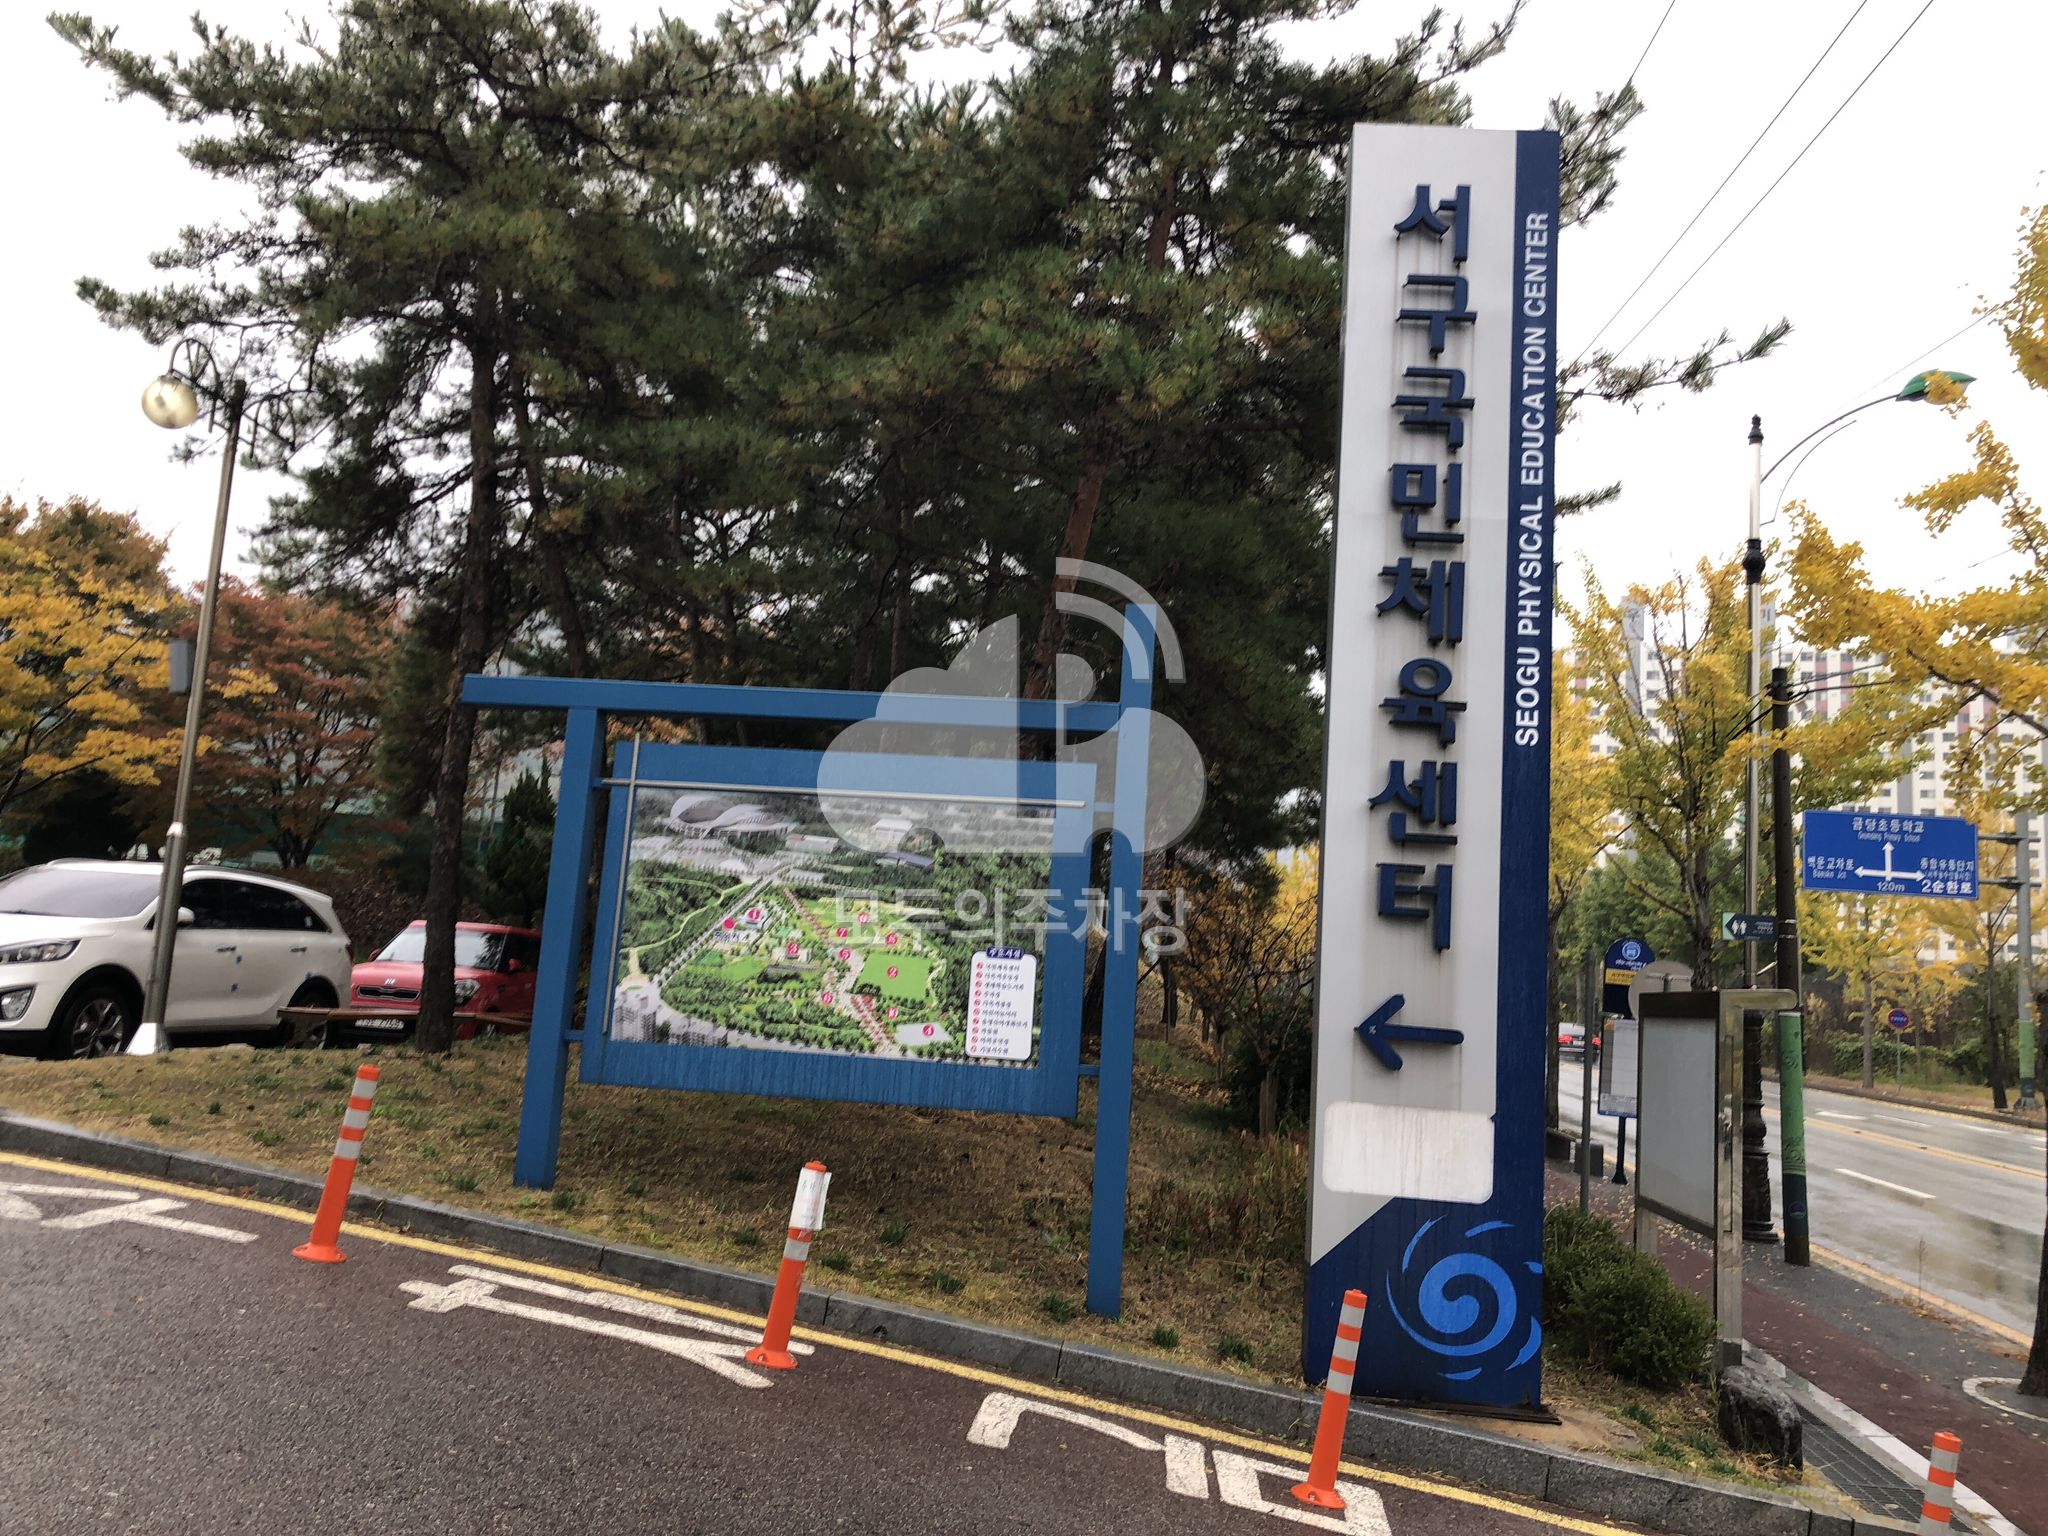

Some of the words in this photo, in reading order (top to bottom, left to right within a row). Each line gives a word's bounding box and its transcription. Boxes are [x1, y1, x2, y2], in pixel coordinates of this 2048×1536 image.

[1523, 212, 1550, 318] CENTER
[1520, 326, 1548, 486] EDUCATION
[1368, 183, 1478, 953] 서구국민체육센터
[1517, 495, 1544, 637] PHYSICAL
[1514, 645, 1541, 748] SEOGU
[1852, 816, 1925, 833] 금당초등학교
[1876, 881, 1905, 893] 120m
[1921, 879, 1973, 895] 2순환로
